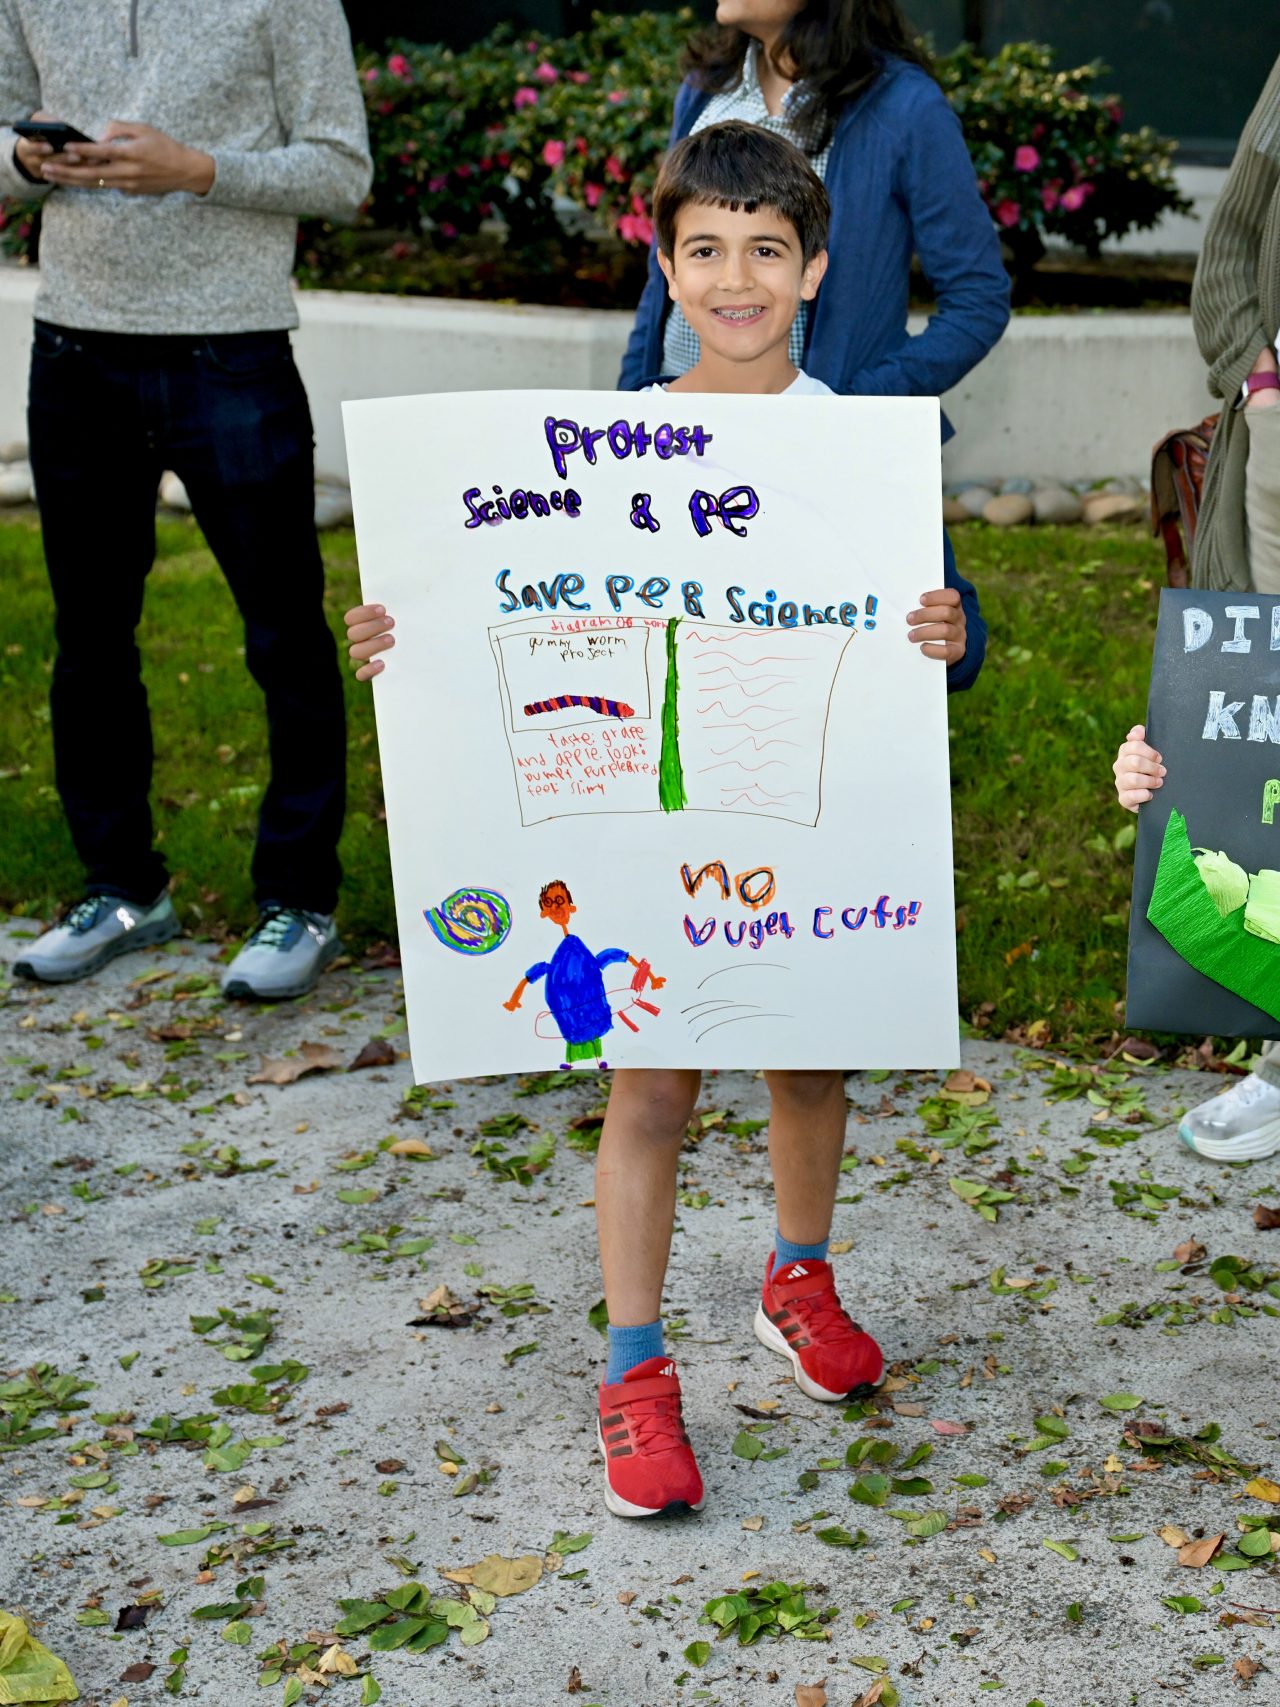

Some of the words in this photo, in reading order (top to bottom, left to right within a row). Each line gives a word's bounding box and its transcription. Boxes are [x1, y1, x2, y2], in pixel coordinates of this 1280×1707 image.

[630, 493, 661, 533] &
[496, 568, 591, 614] Save
[726, 585, 879, 630] Science!
[551, 616, 612, 632] diagram
[587, 635, 627, 647] worm
[602, 726, 648, 747] grape
[517, 752, 546, 768] and
